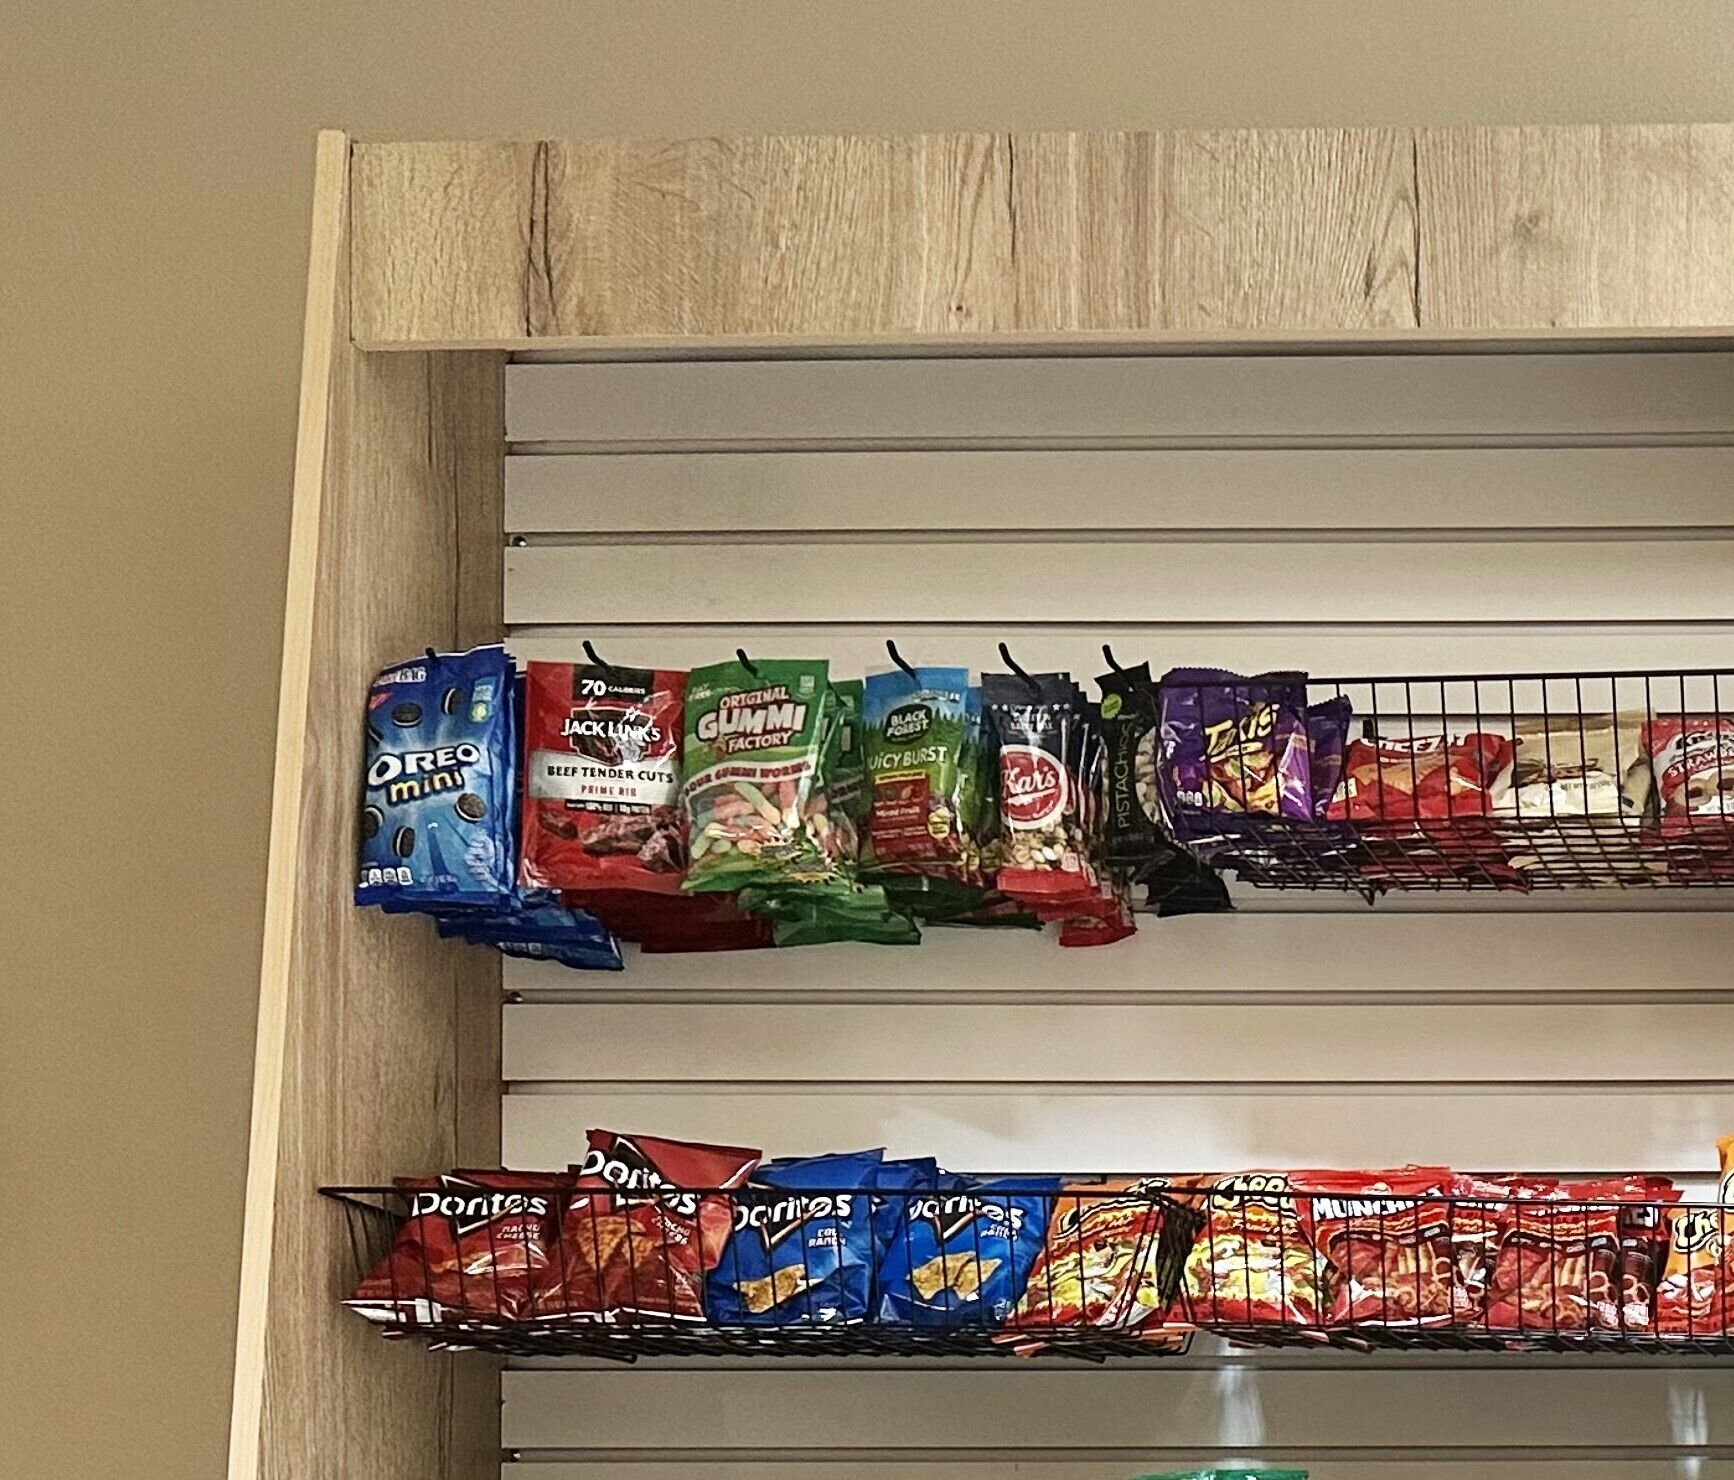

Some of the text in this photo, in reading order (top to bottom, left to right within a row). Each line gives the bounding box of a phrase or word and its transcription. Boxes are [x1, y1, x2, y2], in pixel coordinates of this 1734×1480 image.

[581, 679, 606, 695] 70
[720, 687, 790, 708] ORIGINAL
[698, 704, 807, 740] GUMMI
[886, 720, 930, 737] FOREST
[890, 710, 927, 726] BLACK
[561, 719, 661, 742] JACK LINK'S
[728, 732, 792, 752] FACTORY
[367, 743, 480, 786] OREO
[903, 745, 949, 767] BURST
[548, 765, 674, 784] BEEF TENDER CUTS
[714, 766, 758, 780] GUMMI
[760, 761, 812, 779] WORMS
[1003, 766, 1057, 796] Kar's
[390, 768, 464, 803] mini
[580, 784, 638, 797] PRIME RIB
[412, 1191, 548, 1217] Doritos
[734, 1194, 853, 1232] Doritos
